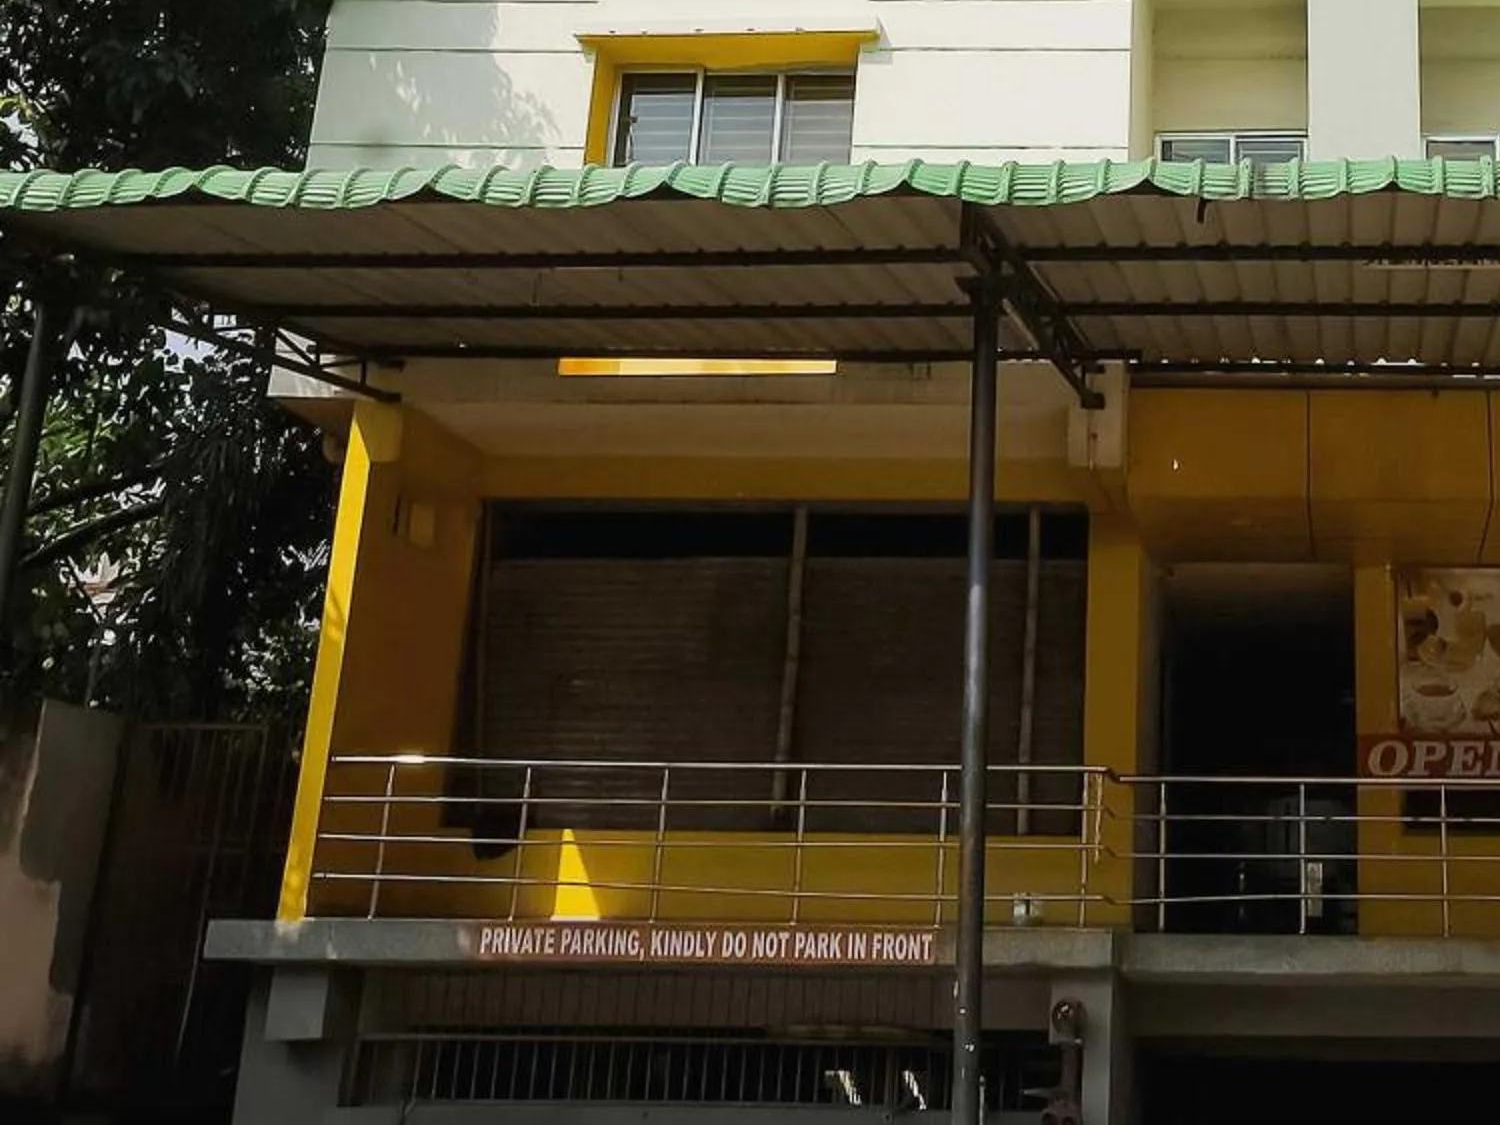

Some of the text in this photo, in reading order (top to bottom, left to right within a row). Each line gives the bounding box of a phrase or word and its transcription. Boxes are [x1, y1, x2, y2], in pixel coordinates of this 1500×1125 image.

[479, 927, 934, 961] PRIVATE PARKING, KINDLY DO NOT PARK IN FRONT
